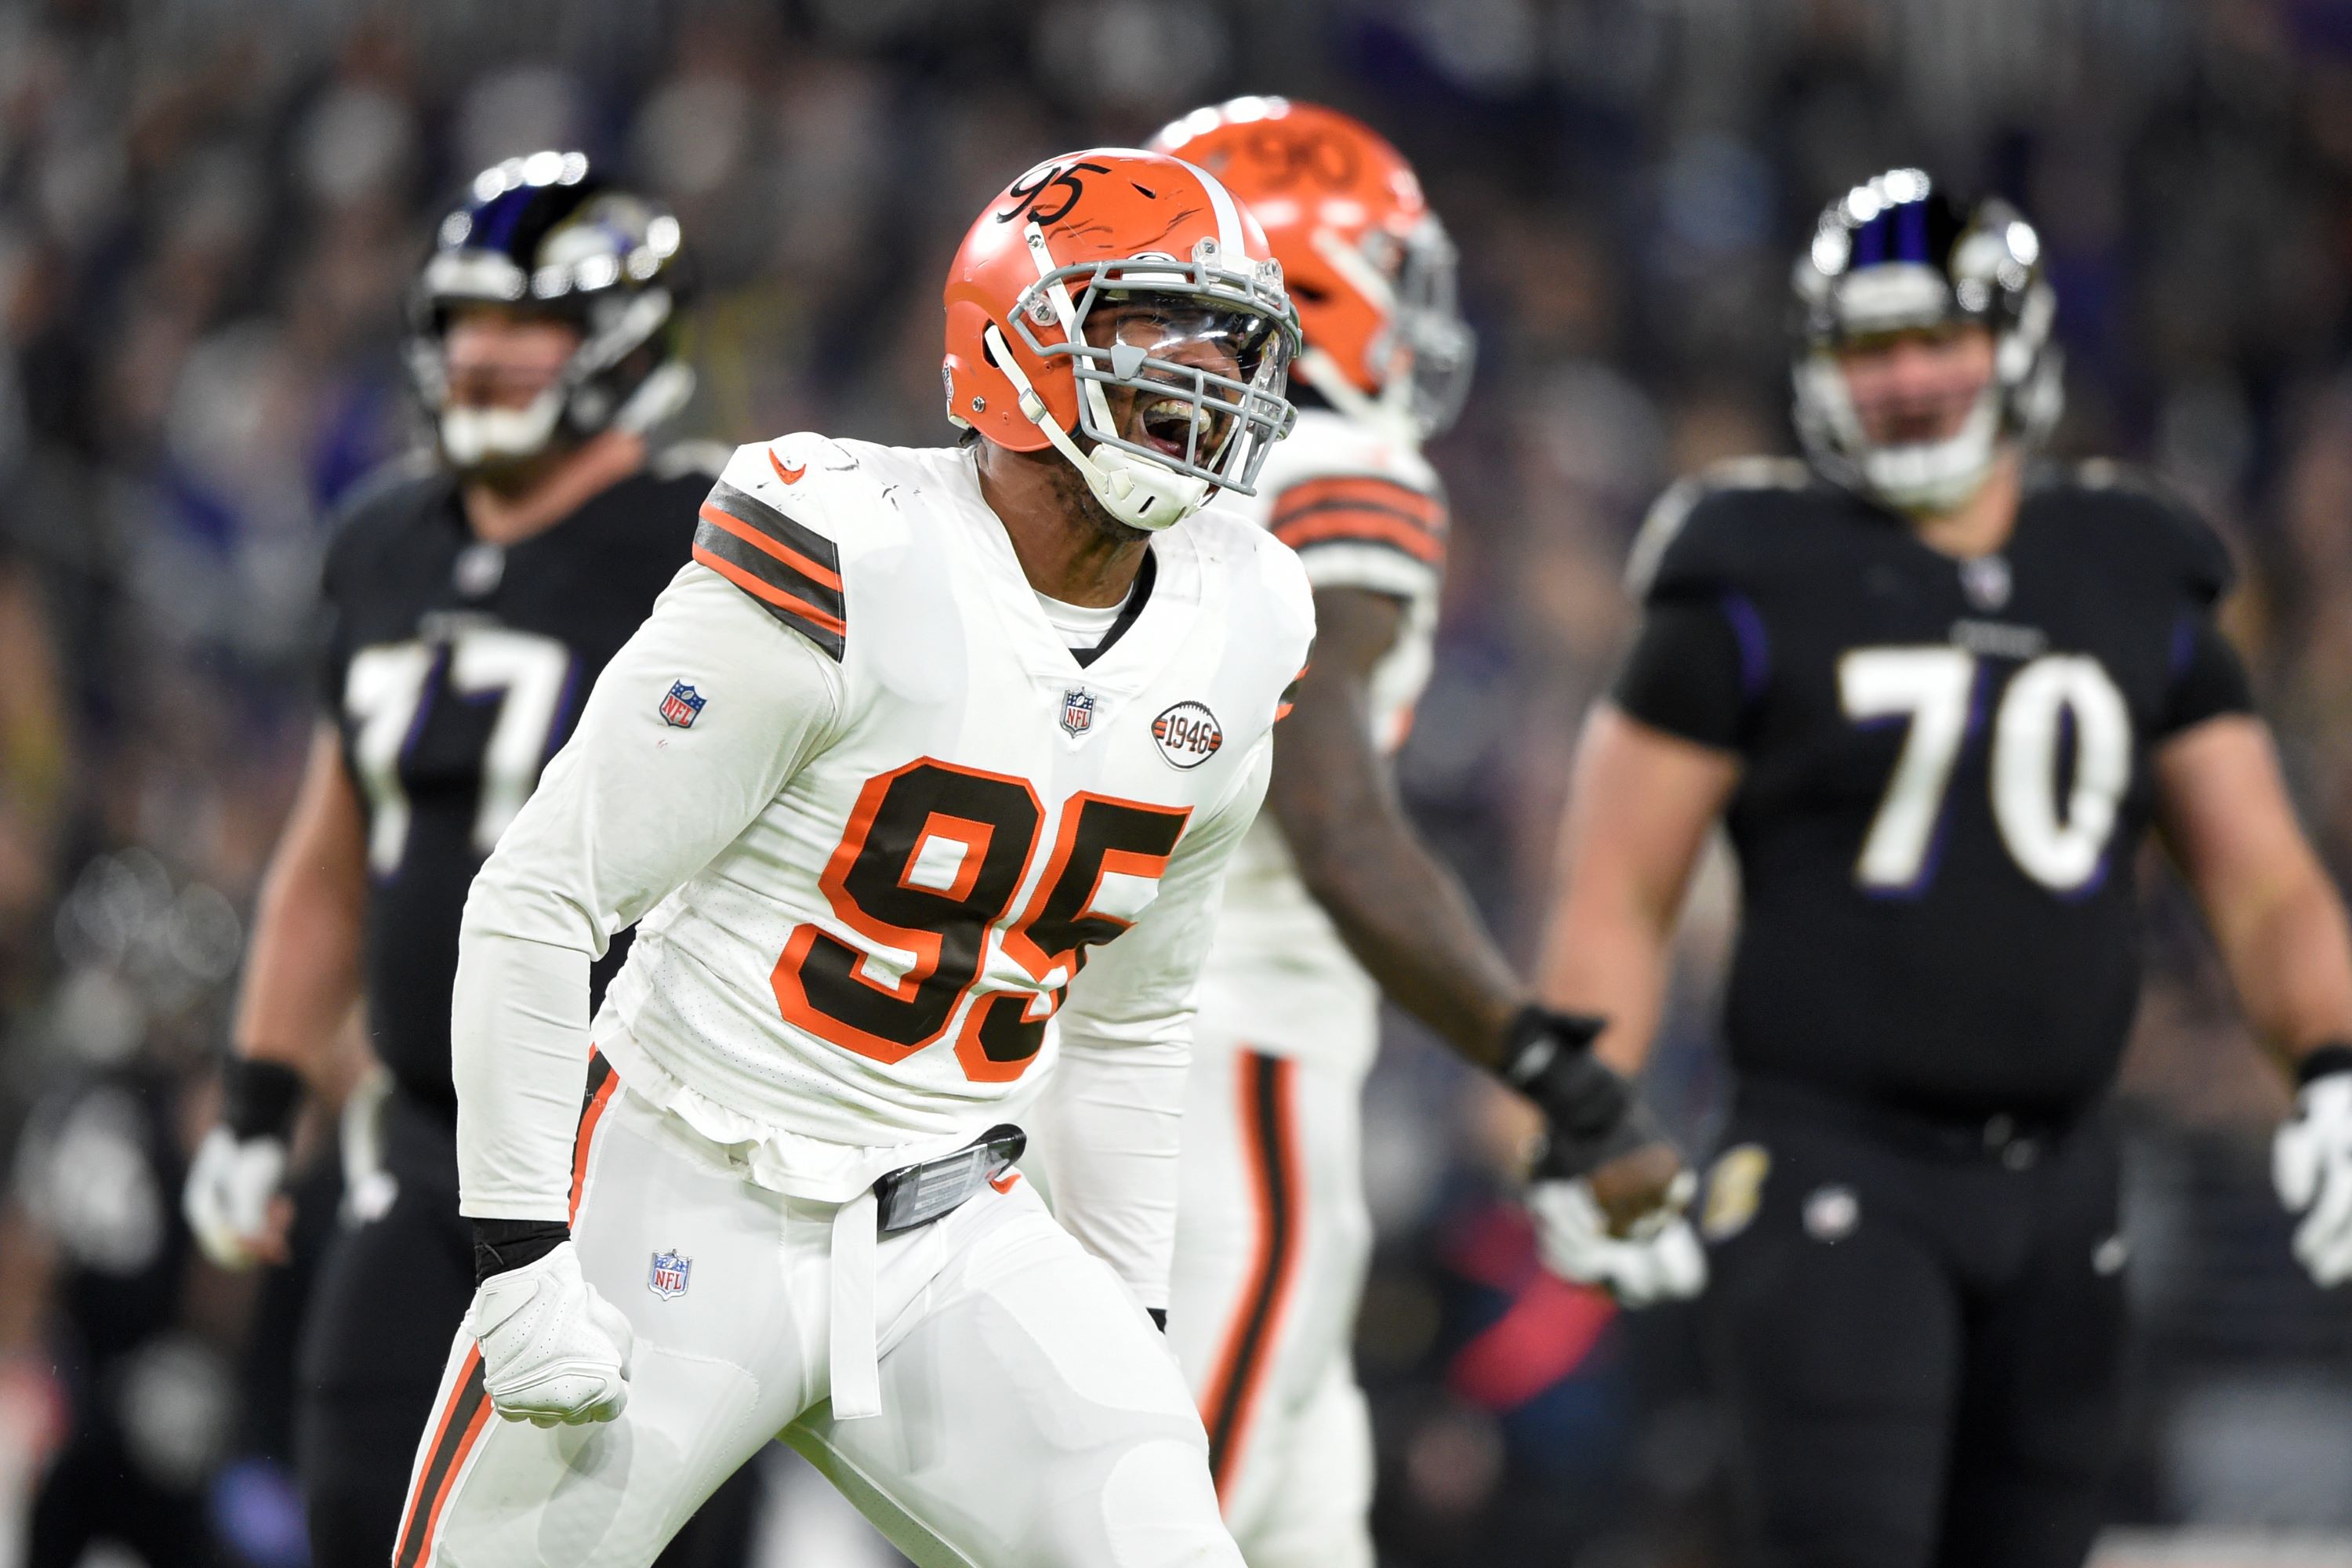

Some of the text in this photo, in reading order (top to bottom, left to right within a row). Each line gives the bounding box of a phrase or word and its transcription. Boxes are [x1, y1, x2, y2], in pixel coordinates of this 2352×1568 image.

[1243, 125, 1363, 193] 90
[996, 162, 1112, 226] 95
[662, 695, 694, 726] NFL
[1066, 708, 1088, 728] NFL
[1165, 714, 1212, 754] 1946
[344, 626, 576, 880] 77
[1837, 644, 2133, 897] 70
[770, 755, 1194, 1083] 95
[655, 1269, 682, 1290] NFL
